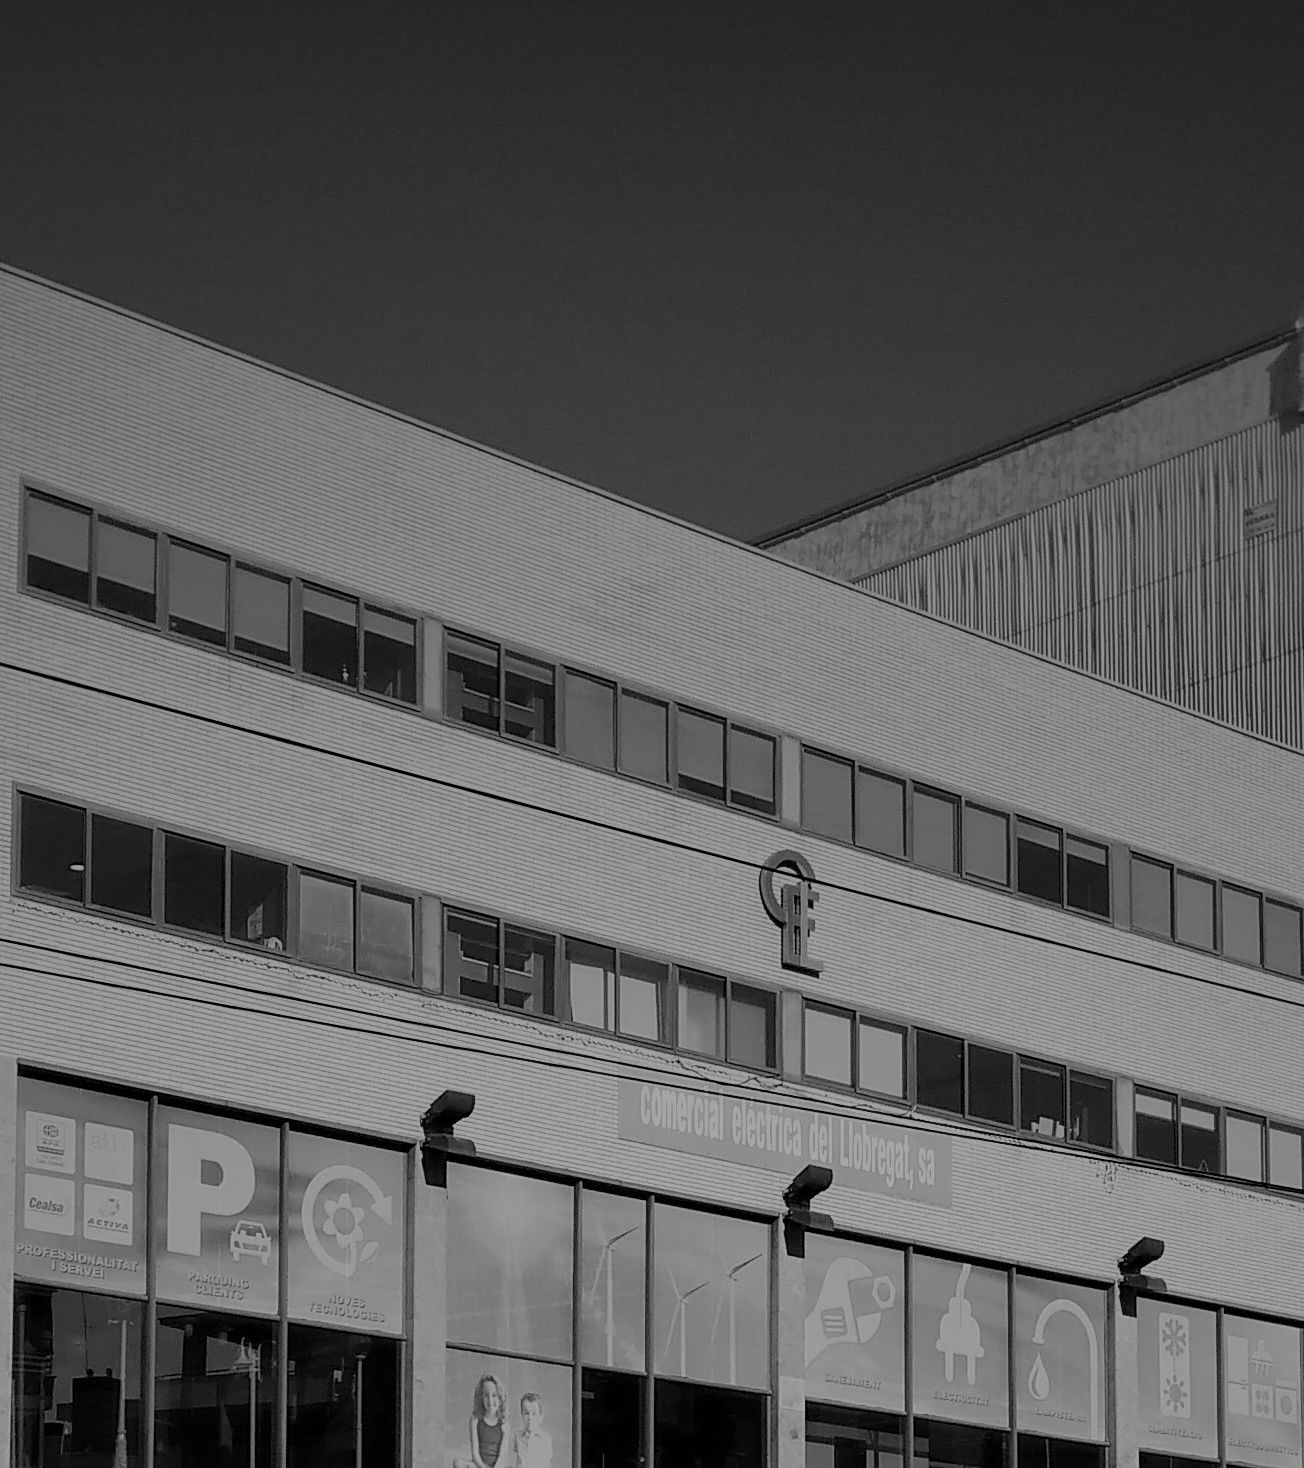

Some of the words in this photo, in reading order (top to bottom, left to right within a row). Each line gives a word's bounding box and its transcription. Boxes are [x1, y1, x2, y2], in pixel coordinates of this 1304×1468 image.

[640, 1085, 725, 1140] comercial
[808, 1115, 833, 1163] del
[840, 1117, 914, 1189] Llobregat,
[918, 1147, 935, 1186] sa
[168, 1123, 256, 1256] P
[29, 1196, 64, 1213] Cealsa
[87, 1218, 129, 1231] ACTIVA
[16, 1243, 140, 1272] PROFESSIONALITAT
[51, 1261, 57, 1271] I
[60, 1262, 106, 1279] SERVEI
[194, 1284, 245, 1301] CLIENTS
[328, 1294, 367, 1309] NOVES
[308, 1302, 386, 1323] TECNOLOGIES
